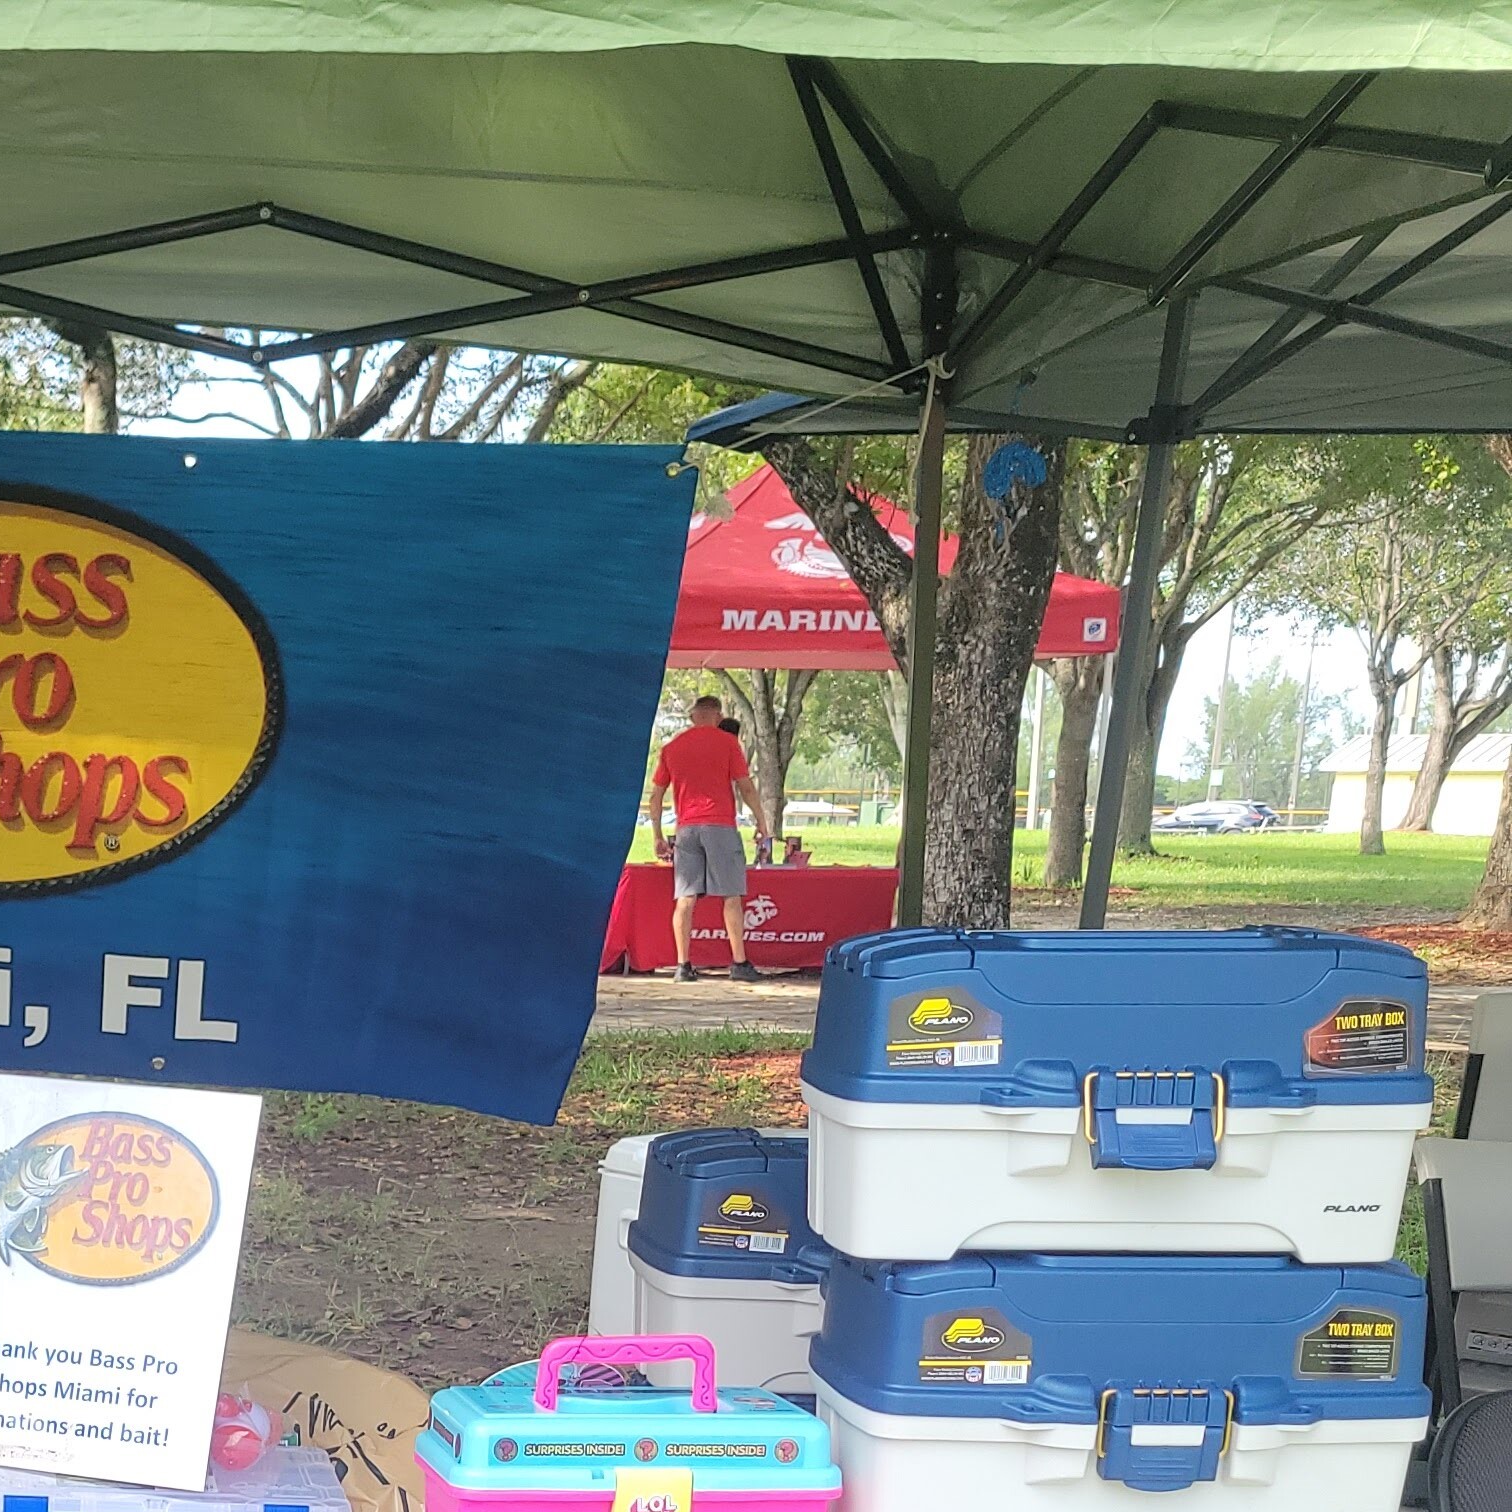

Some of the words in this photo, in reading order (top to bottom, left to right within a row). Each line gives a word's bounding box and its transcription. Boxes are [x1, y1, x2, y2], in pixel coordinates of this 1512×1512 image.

[100, 952, 238, 1044] FL
[1335, 1015, 1358, 1030] TWO
[1359, 1012, 1383, 1028] TRAY
[1385, 1011, 1405, 1026] BOX
[80, 1119, 173, 1167] Bass
[76, 1160, 150, 1206] Pro
[1323, 1204, 1381, 1213] PLANO
[72, 1199, 192, 1263] Shops
[1328, 1323, 1350, 1337] TWO
[1351, 1323, 1374, 1337] TRAY
[1374, 1323, 1394, 1337] BOX
[45, 1347, 82, 1367] you
[90, 1348, 135, 1372] Bass
[142, 1354, 179, 1376] Pro
[53, 1379, 122, 1406] Miami
[126, 1387, 159, 1410] for
[74, 1420, 113, 1442] and
[120, 1424, 170, 1447] bait!
[525, 1443, 584, 1456] SURPRISES
[586, 1443, 626, 1455] INSIDE!
[666, 1444, 725, 1456] SURPRISES
[727, 1444, 766, 1456] INSIDE!
[636, 1495, 678, 1512] LOL
